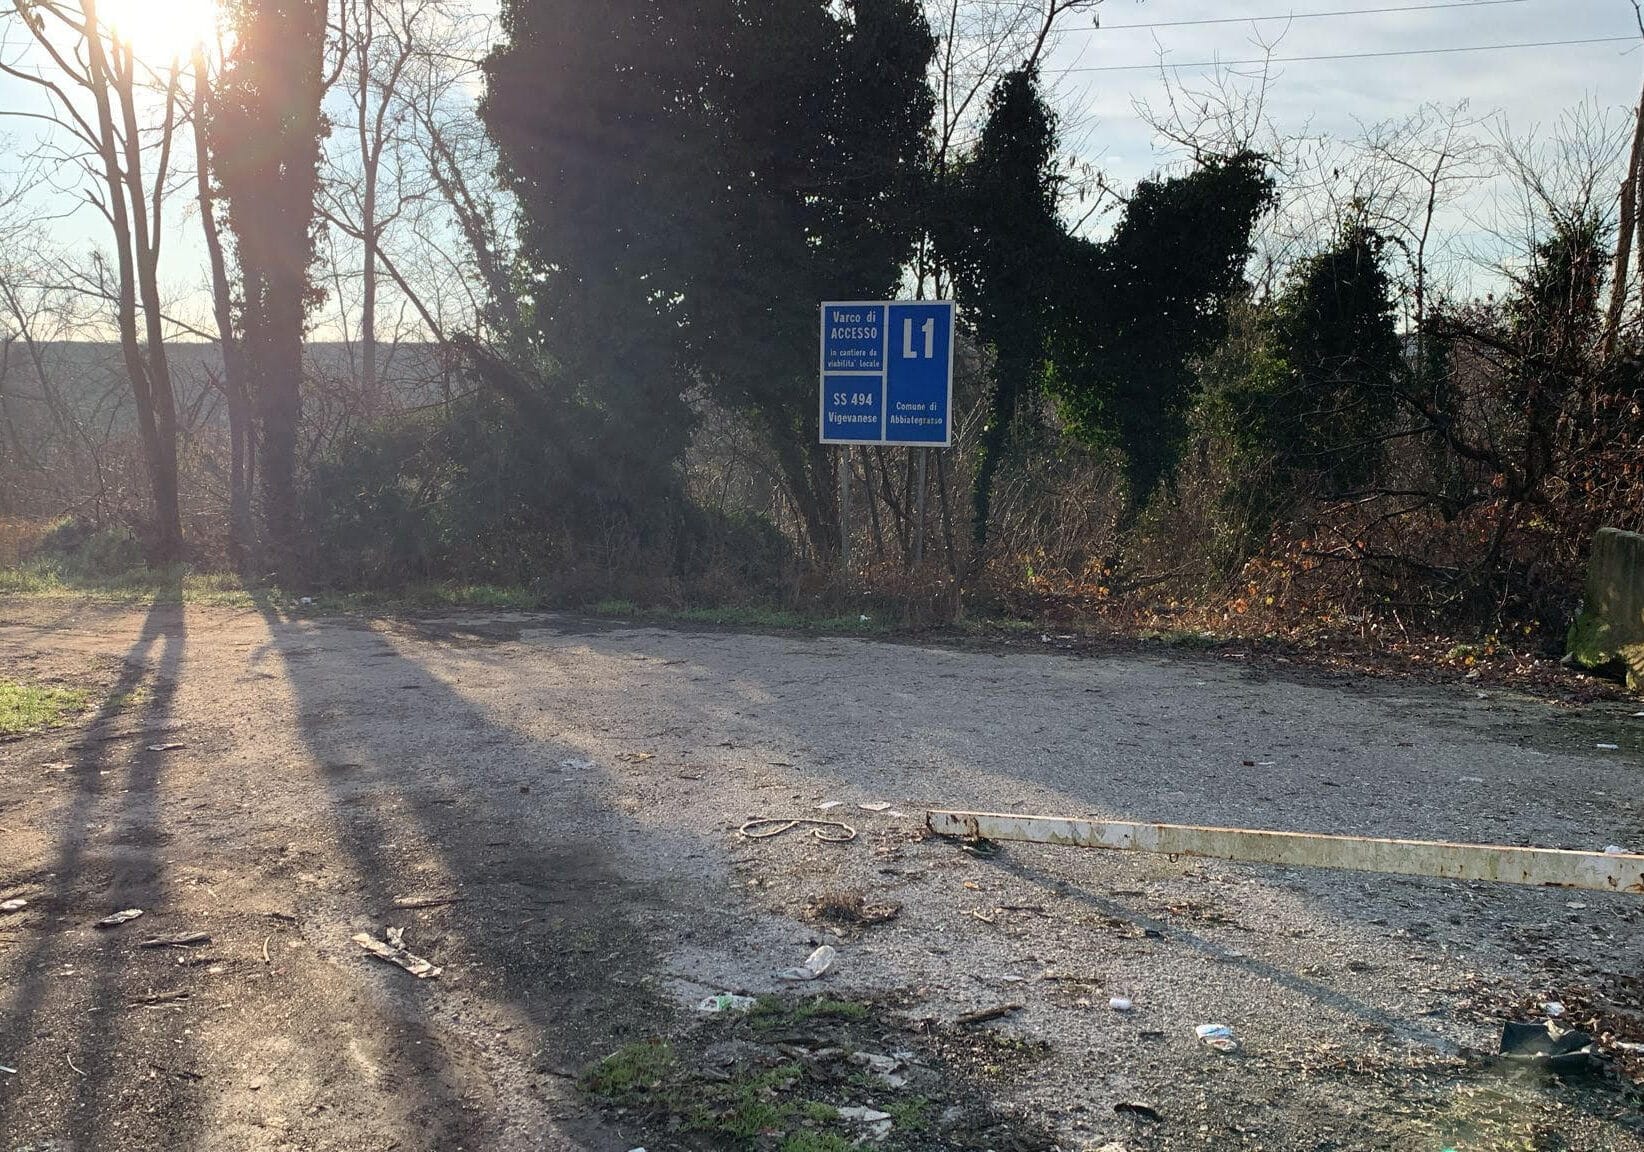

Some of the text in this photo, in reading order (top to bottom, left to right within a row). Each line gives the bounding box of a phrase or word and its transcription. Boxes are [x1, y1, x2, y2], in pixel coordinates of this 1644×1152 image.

[833, 310, 876, 323] Varco di
[831, 327, 878, 340] ACCESSO
[903, 317, 935, 359] L1
[833, 392, 873, 406] SS 494
[896, 401, 937, 411] Comune di
[828, 411, 878, 425] Vigevanese
[890, 414, 943, 426] Abbiategrasso
